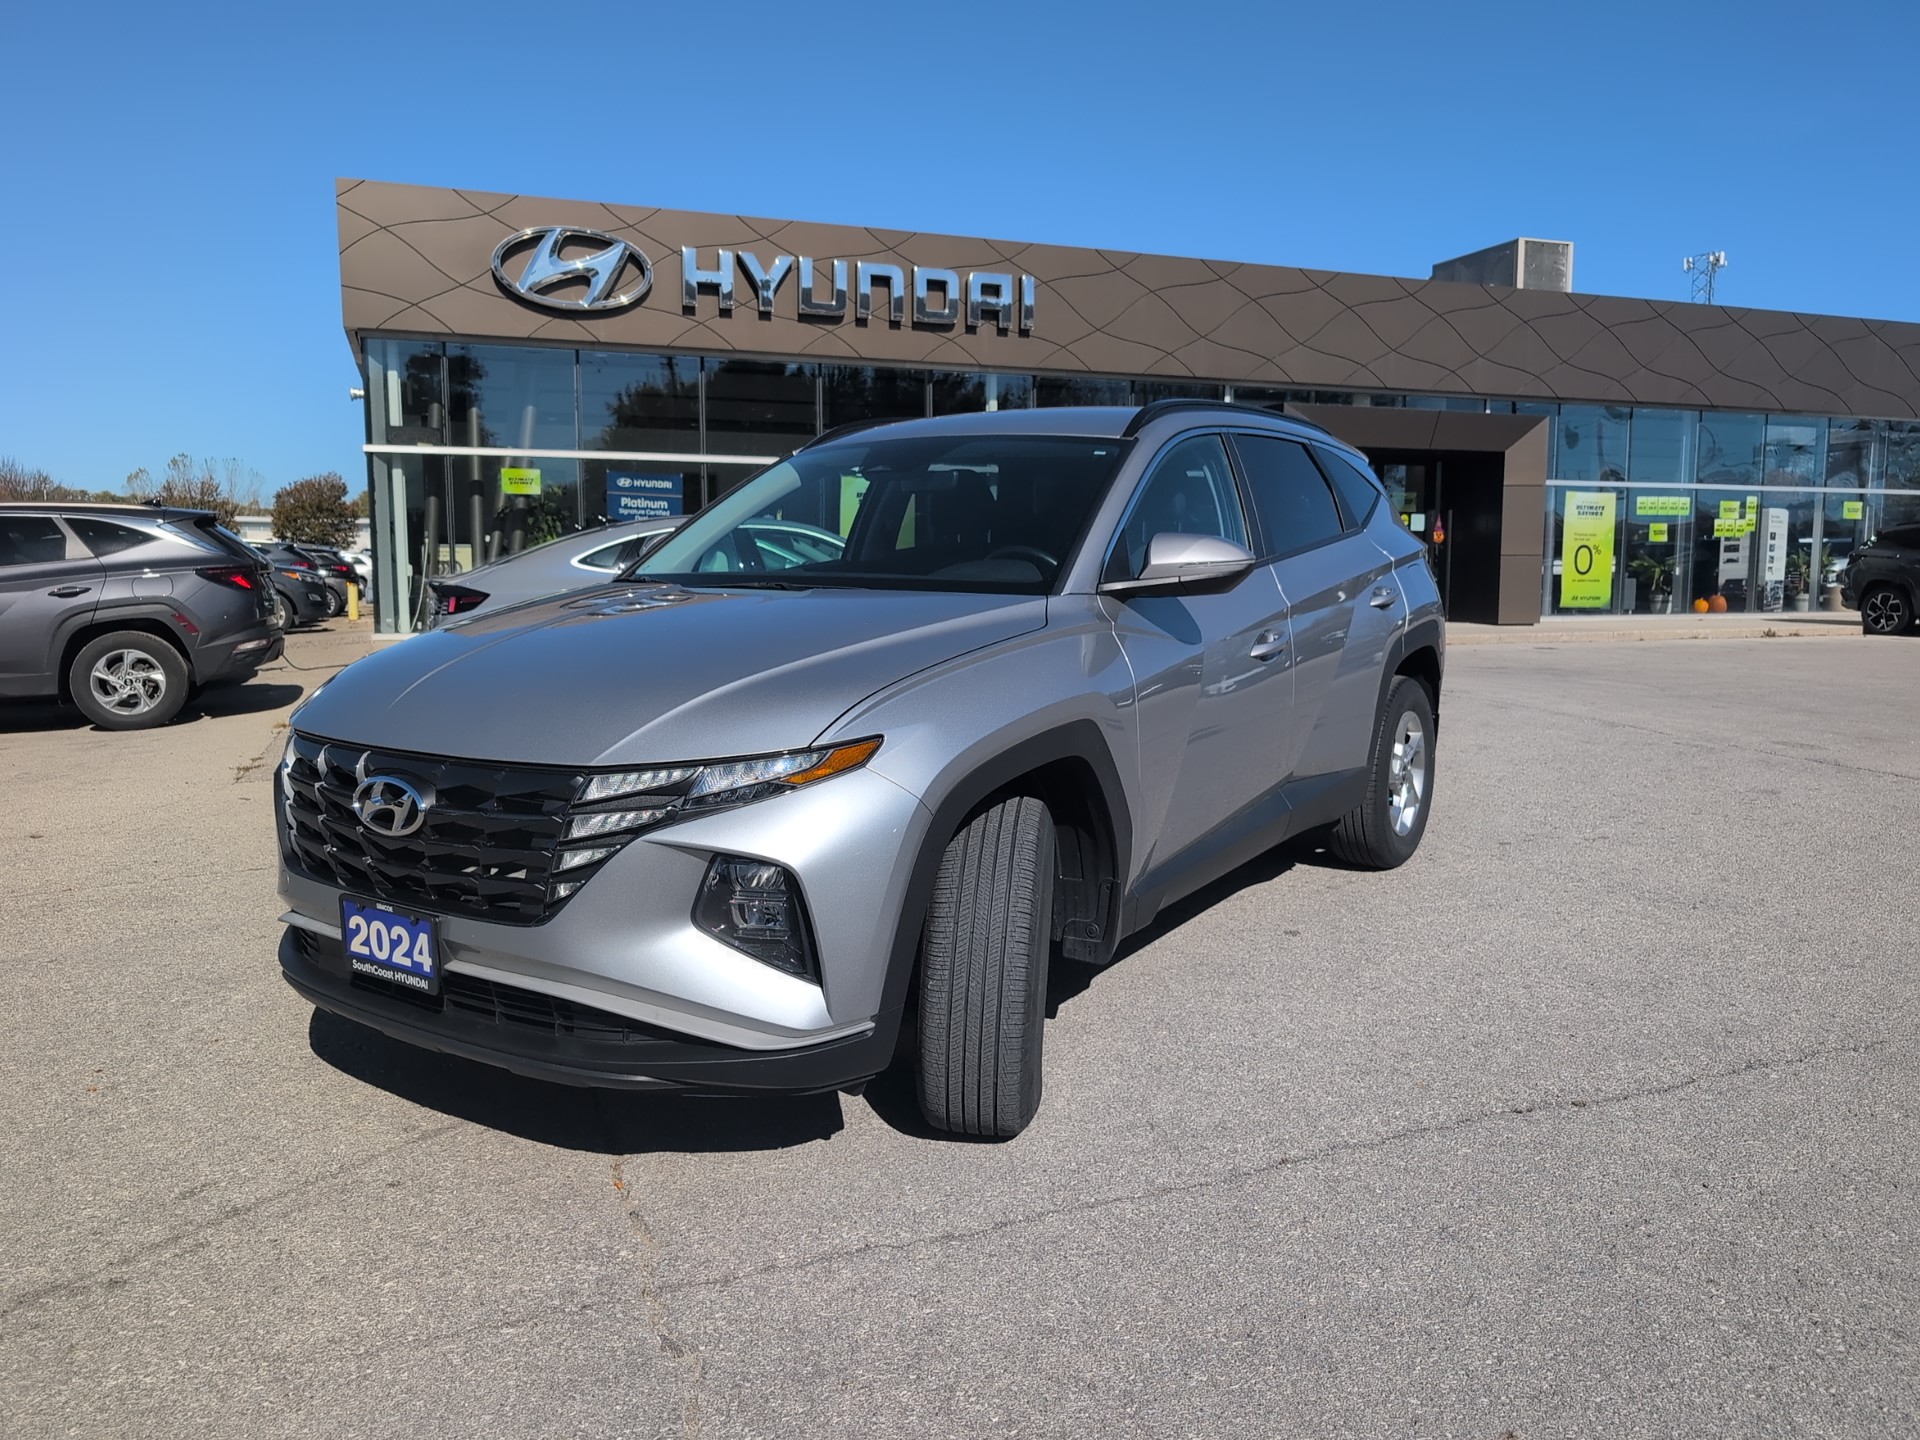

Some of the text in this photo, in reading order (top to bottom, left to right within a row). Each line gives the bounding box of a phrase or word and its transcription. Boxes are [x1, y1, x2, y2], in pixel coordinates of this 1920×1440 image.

[682, 245, 1035, 331] HYUNDAI
[633, 479, 673, 489] HYUNDAI
[621, 497, 668, 509] Platinum
[348, 915, 433, 973] 2024
[352, 959, 429, 990] SouthCoast HYUNDAI
